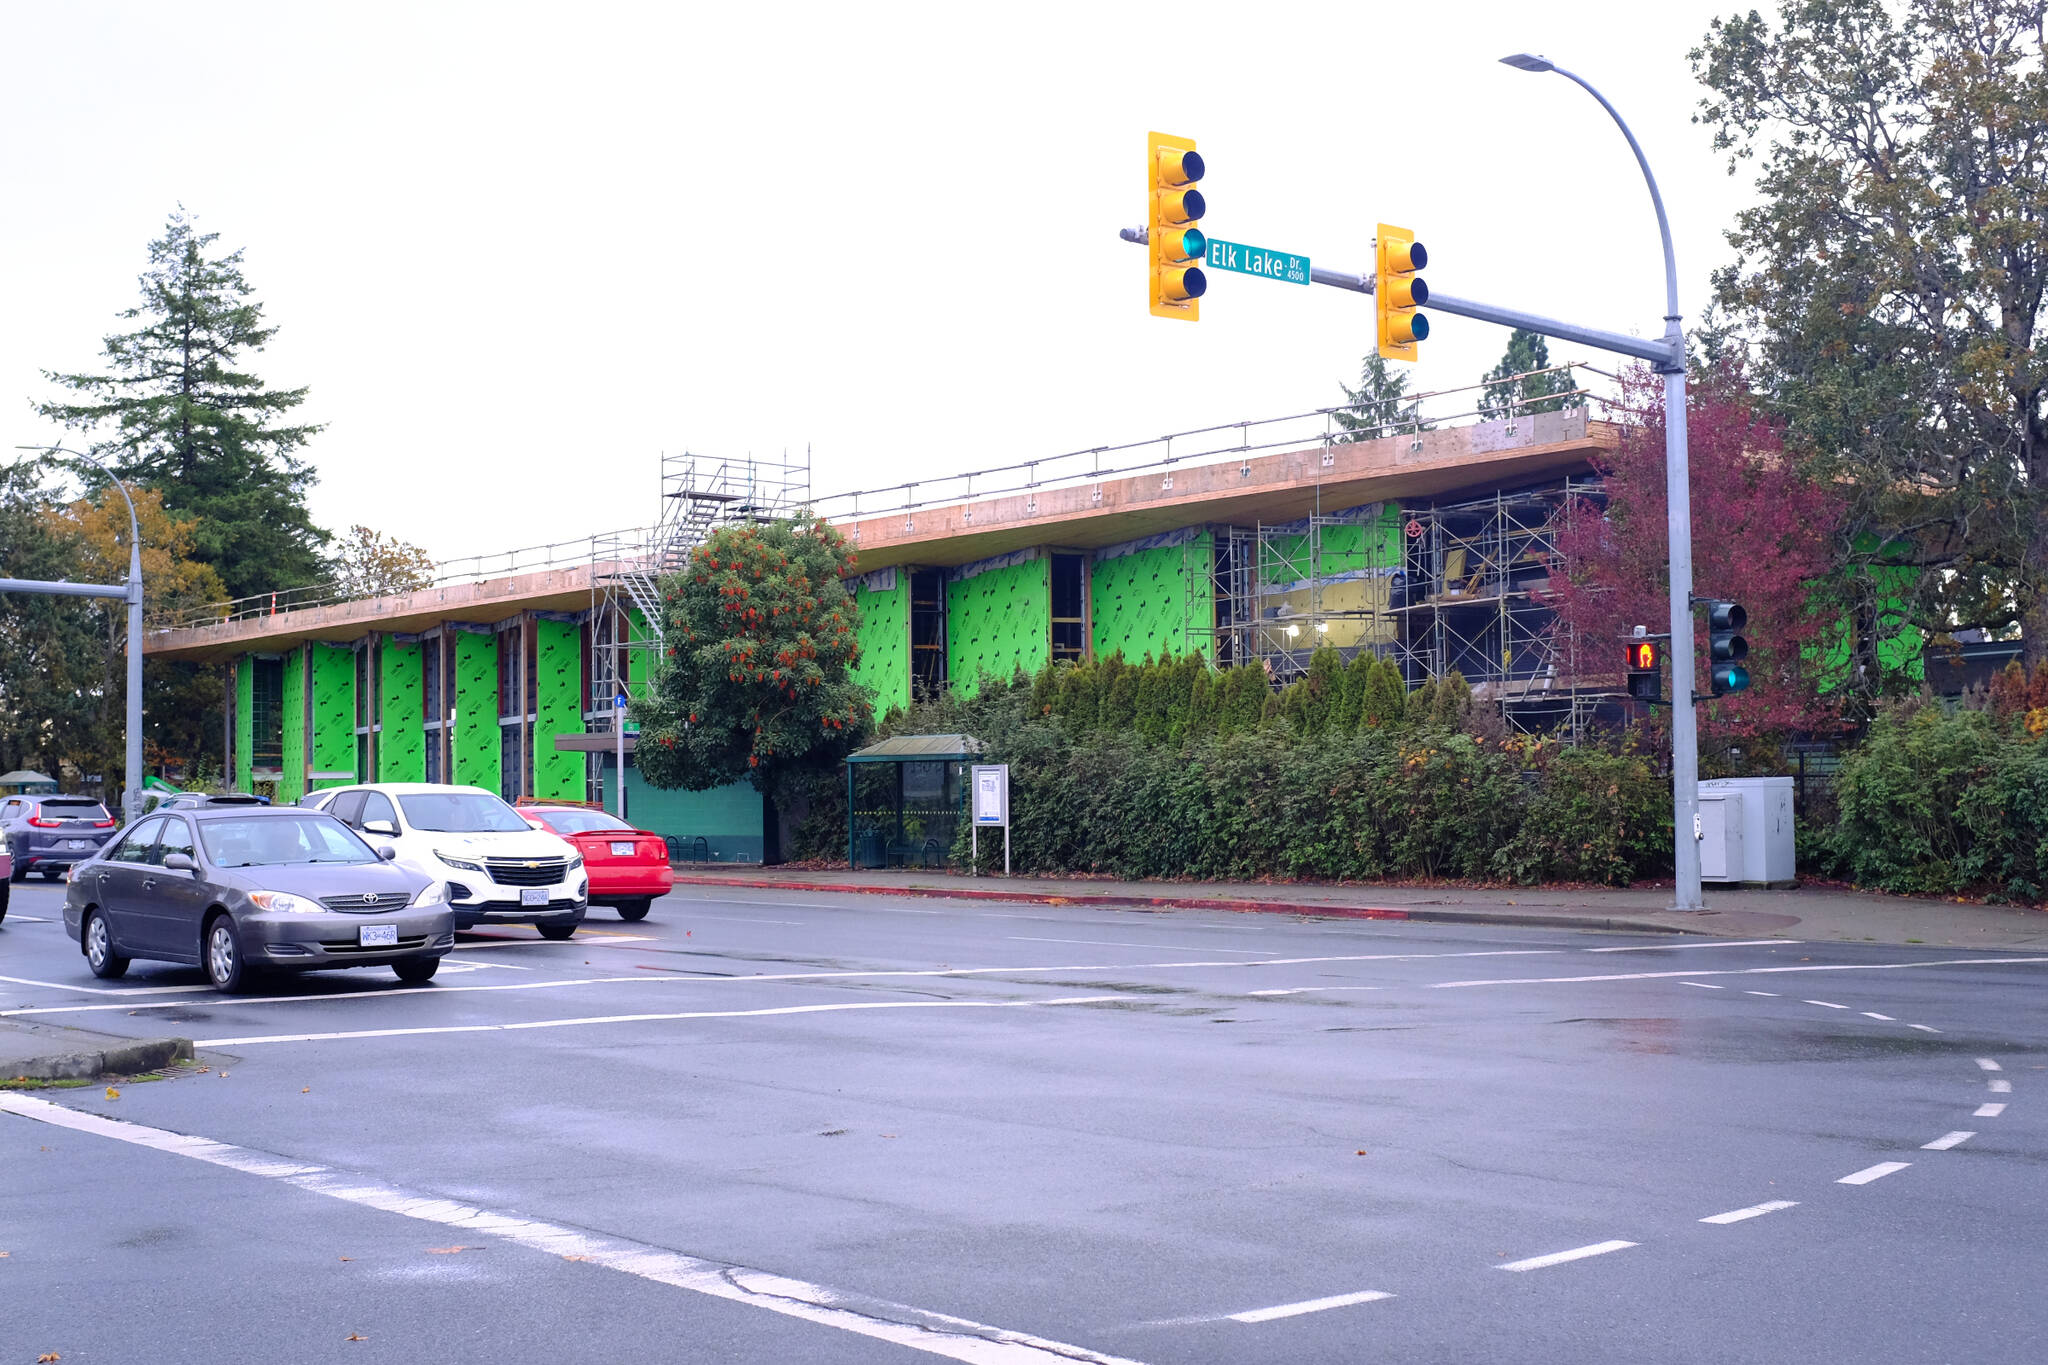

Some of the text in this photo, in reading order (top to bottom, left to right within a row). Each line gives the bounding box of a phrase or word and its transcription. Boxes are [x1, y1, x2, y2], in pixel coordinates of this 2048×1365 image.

[1212, 243, 1302, 277] Elk Lake Dr.
[1287, 270, 1304, 282] 4500
